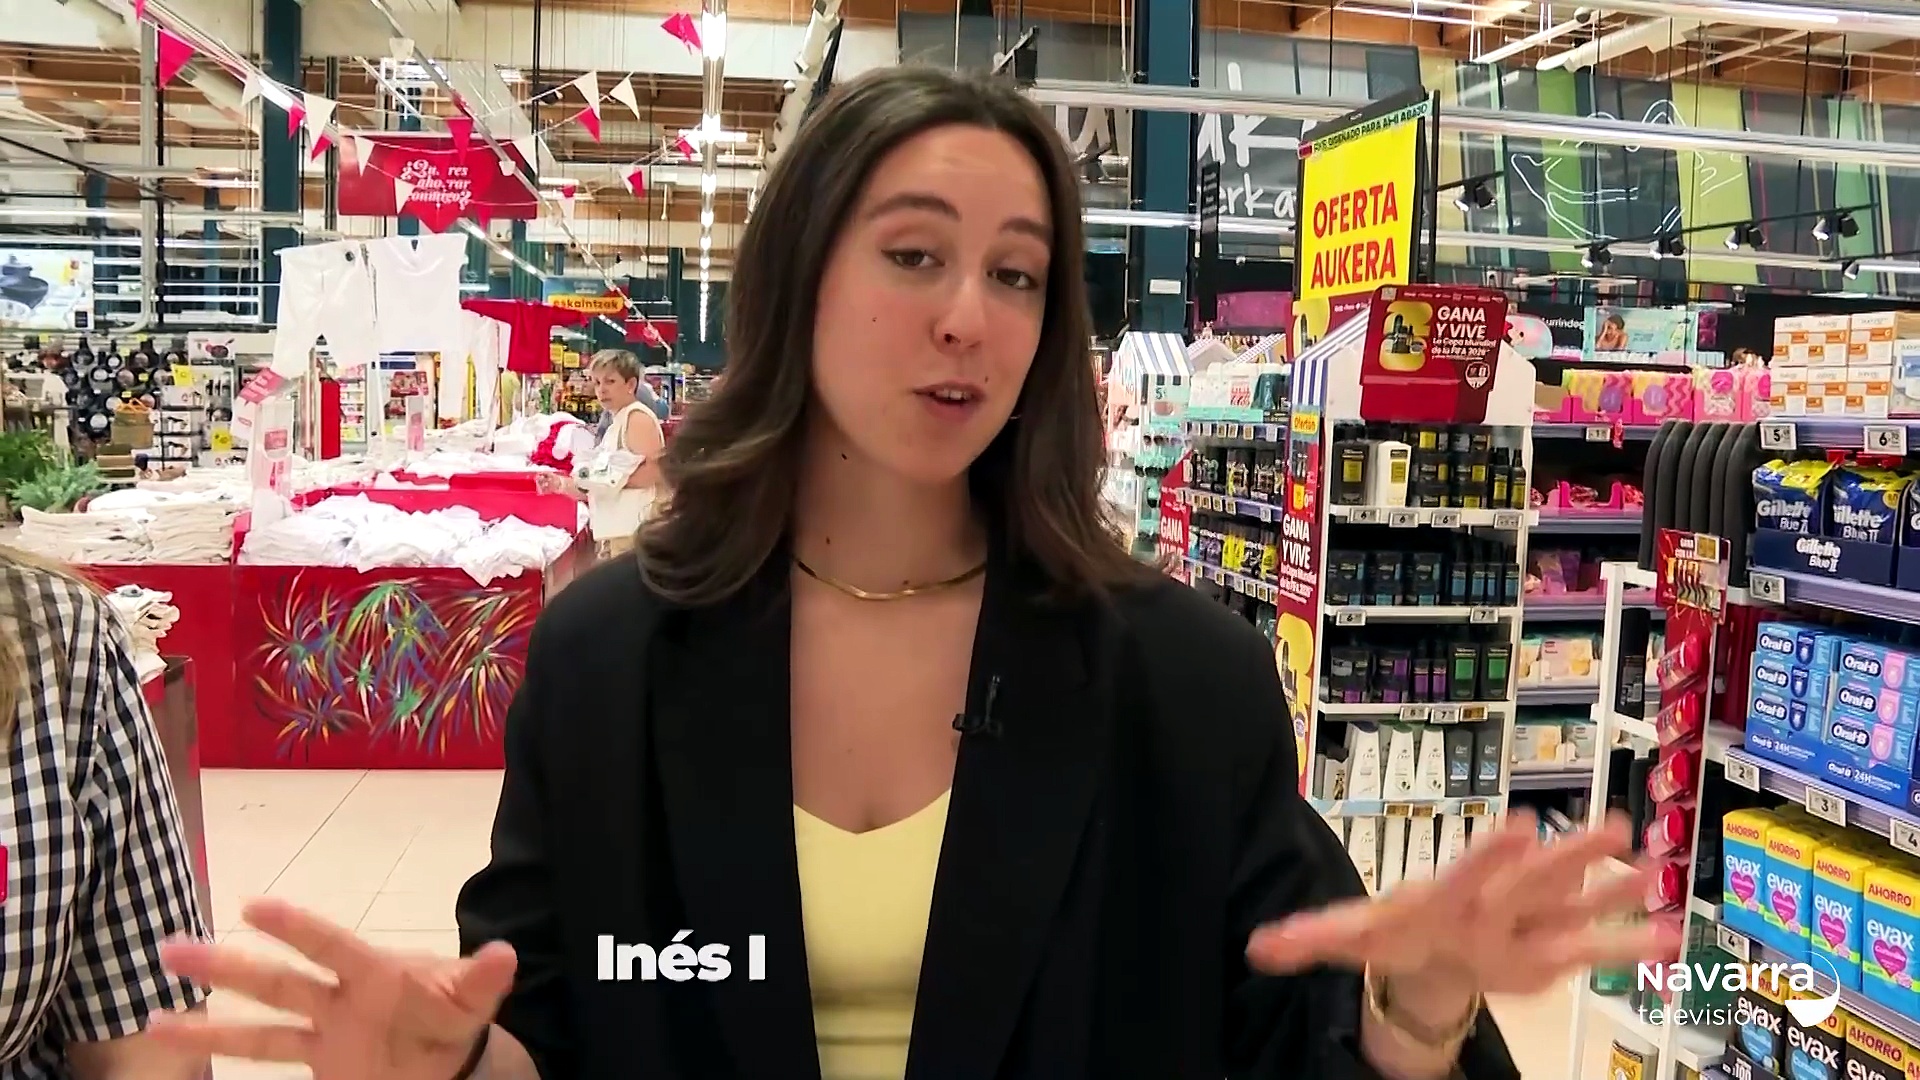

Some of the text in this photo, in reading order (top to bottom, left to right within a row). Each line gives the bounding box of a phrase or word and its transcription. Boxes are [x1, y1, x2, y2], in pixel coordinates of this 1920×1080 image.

[1313, 181, 1399, 239] OFERTA
[1311, 237, 1396, 289] AUKERA
[1437, 305, 1486, 322] GANA
[1435, 322, 1488, 339] Y VIVE
[1757, 499, 1812, 519] Gillette
[1160, 515, 1184, 544] GANA
[1283, 513, 1310, 542] GANA
[1282, 540, 1311, 570] Y VIVE
[1796, 537, 1842, 559] Gillette
[1809, 555, 1829, 569] Blue
[1763, 581, 1771, 594] 6
[1845, 655, 1880, 675] Oral-B
[1755, 699, 1787, 718] Oral-B
[1840, 688, 1875, 710] Oral-B
[1833, 723, 1869, 746] Oral-B
[1738, 768, 1746, 779] 2
[1853, 769, 1872, 784] 24H
[1820, 799, 1829, 813] 3
[1726, 823, 1760, 840] AHORRO
[1908, 833, 1917, 848] 4
[1768, 839, 1801, 860] AHORRO
[1725, 854, 1762, 879] evax
[1815, 860, 1851, 882] AHORRO
[1766, 872, 1803, 899] evax
[1867, 884, 1912, 908] AHORRO
[1814, 894, 1854, 924] evax
[1867, 919, 1915, 952] evax
[1787, 1025, 1840, 1070] evax
[1850, 1026, 1903, 1062] AHORRO
